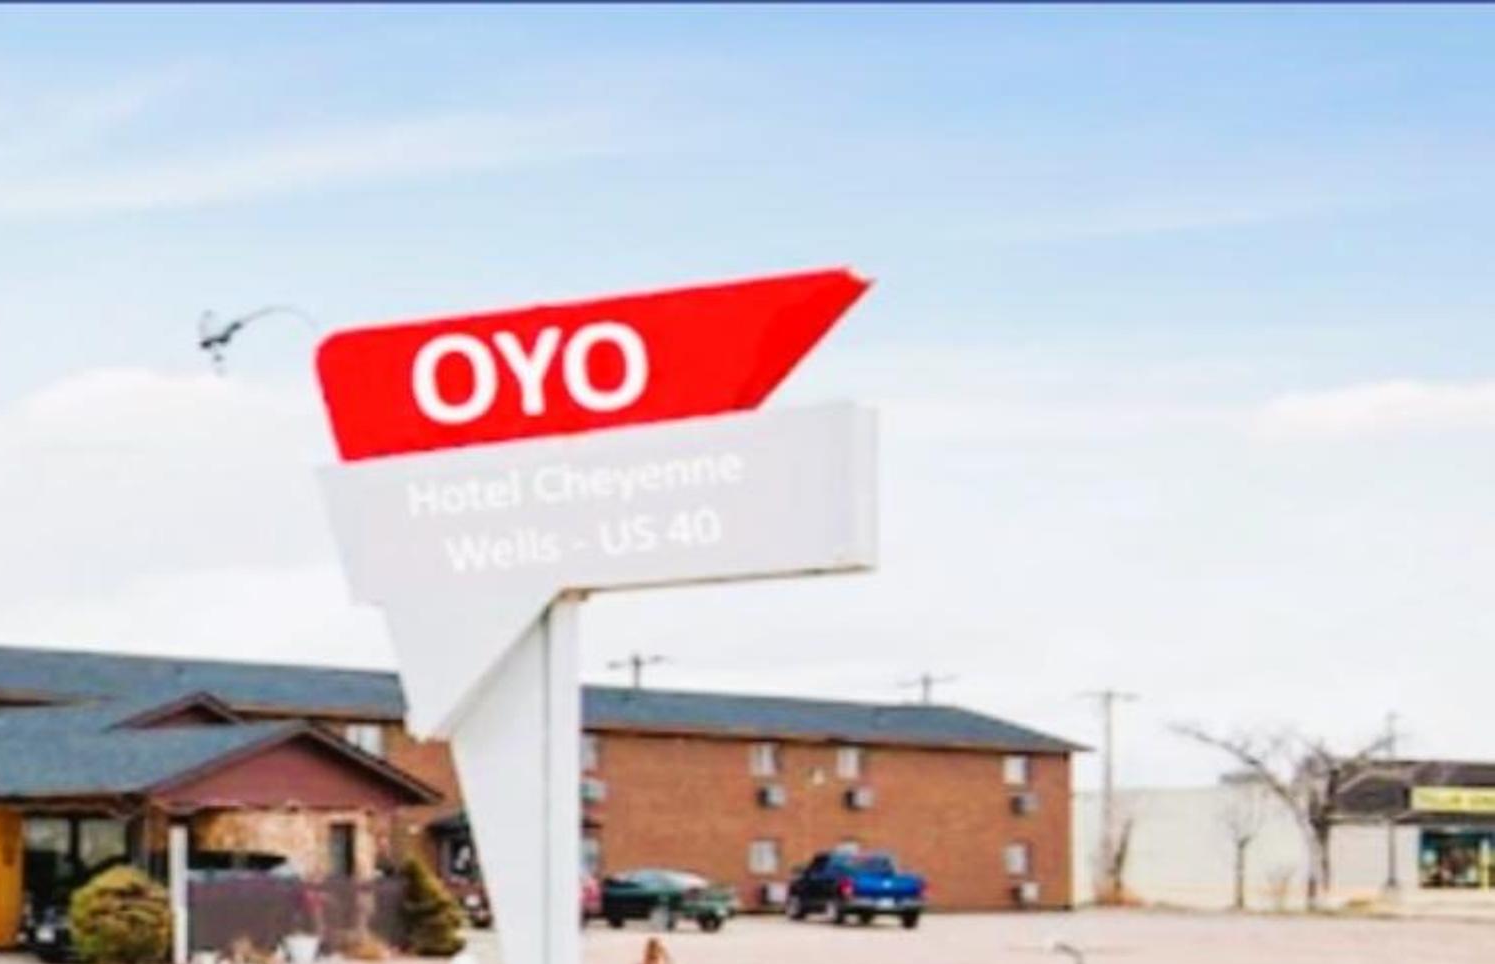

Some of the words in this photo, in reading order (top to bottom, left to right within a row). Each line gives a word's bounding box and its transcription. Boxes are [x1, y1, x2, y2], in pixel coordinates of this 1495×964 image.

[412, 321, 649, 424] OYO
[406, 469, 522, 517] Hotel
[532, 450, 744, 501] Cheyenne
[445, 524, 562, 573] Wells
[599, 515, 657, 555] US
[665, 507, 723, 546] 40
